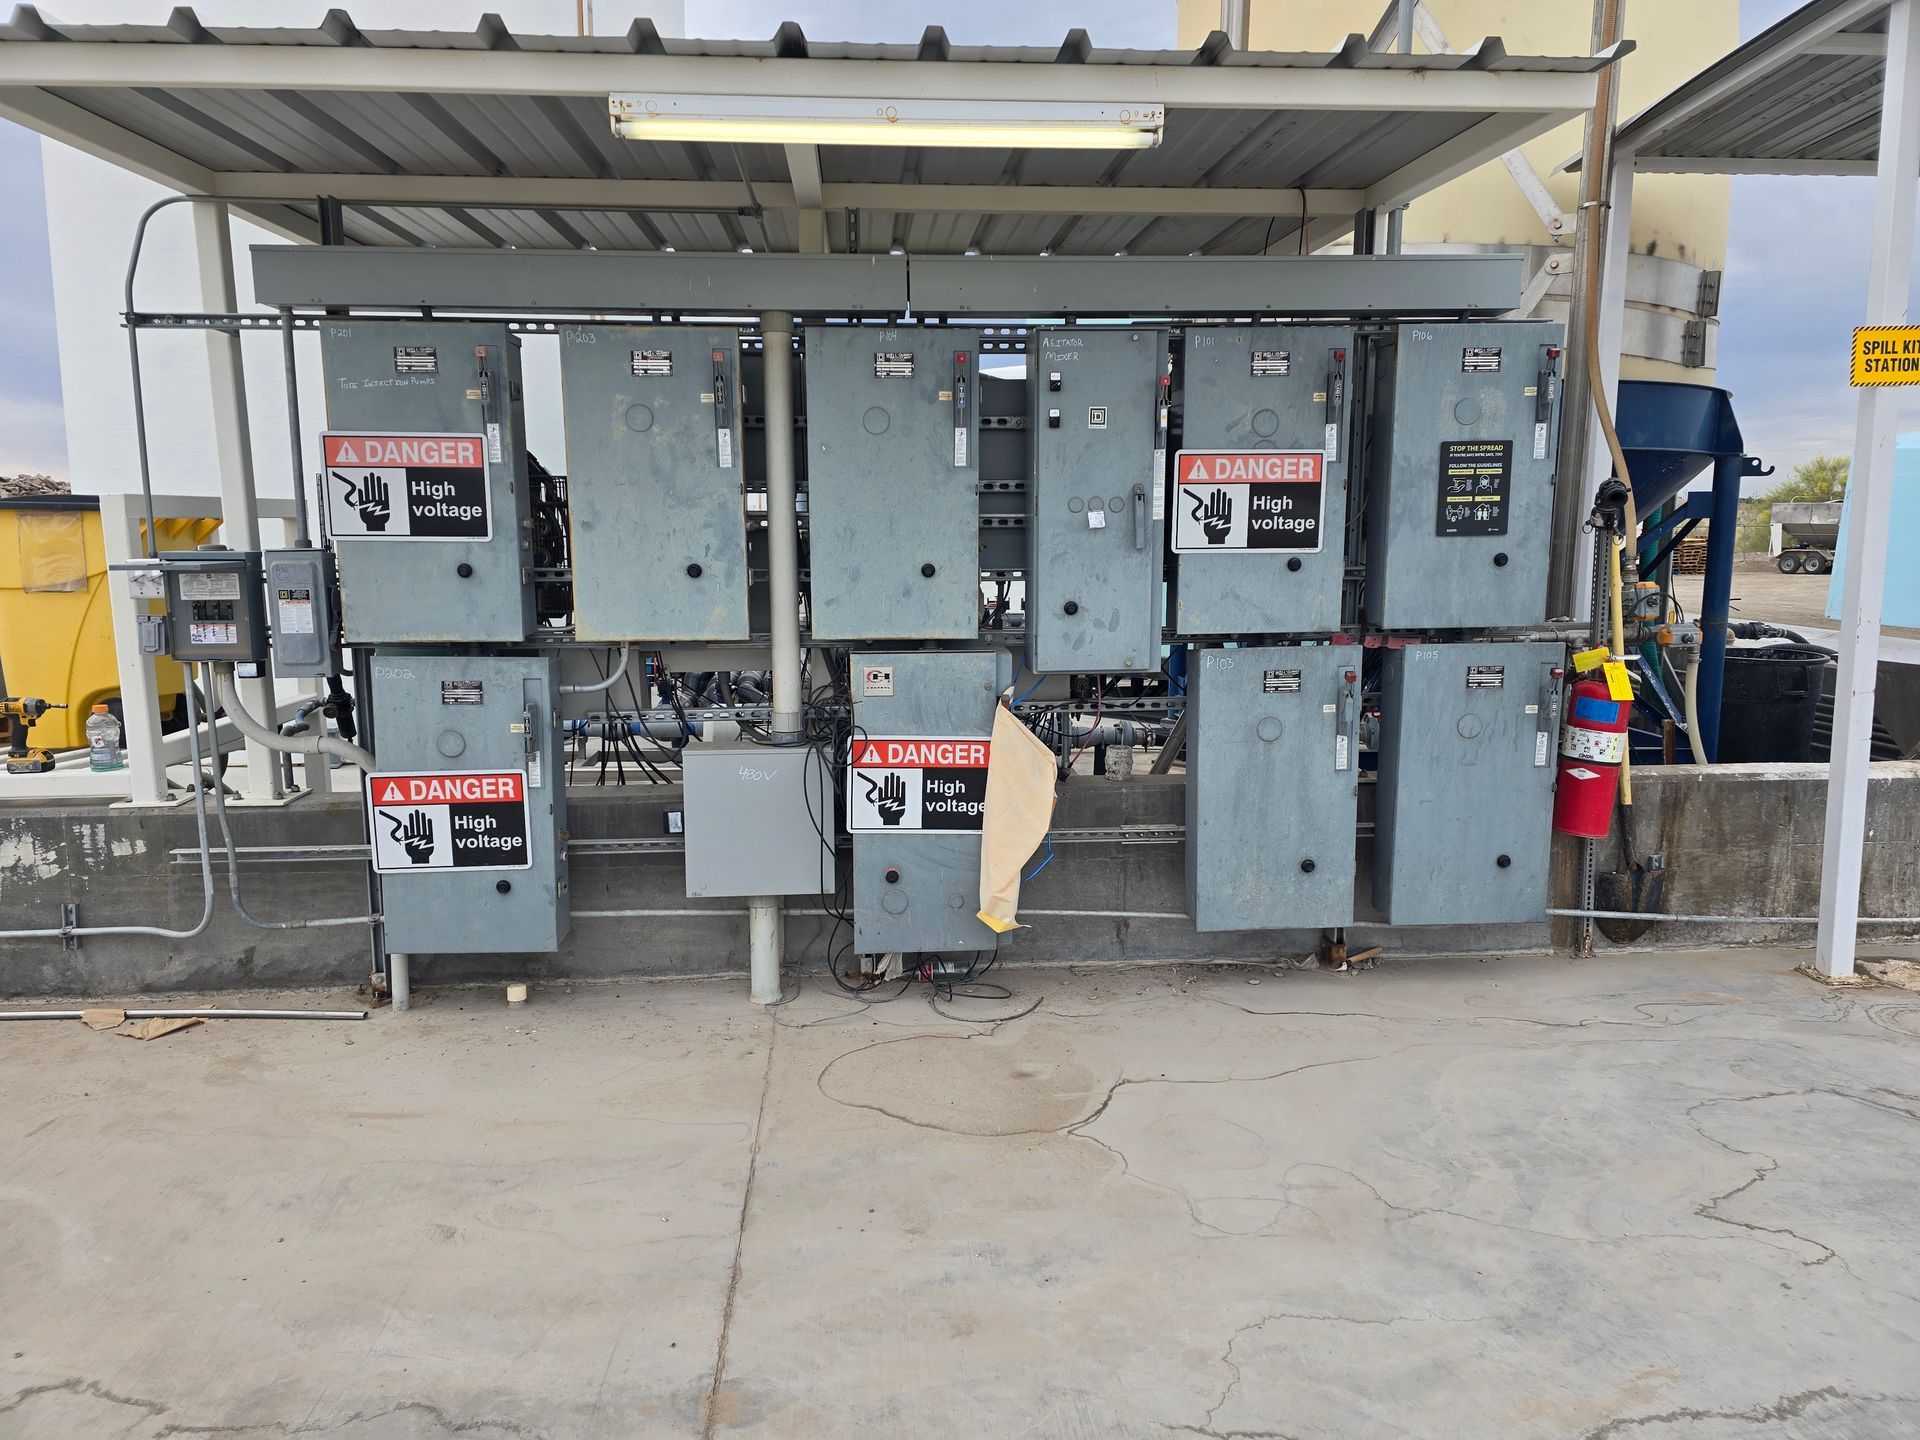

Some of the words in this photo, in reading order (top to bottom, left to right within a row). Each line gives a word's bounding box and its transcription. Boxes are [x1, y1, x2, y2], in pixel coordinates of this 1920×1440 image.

[330, 328, 352, 338] P201
[566, 330, 596, 346] P203
[880, 330, 897, 343] P104
[1042, 337, 1084, 348] AGITATOR
[1195, 335, 1215, 348] P101
[1863, 340, 1898, 355] SPILL
[1045, 351, 1080, 361] MIXER
[1864, 357, 1920, 373] STATION
[365, 440, 475, 465] DANGER
[1215, 458, 1314, 480] DANGER
[411, 480, 456, 500] High
[412, 502, 483, 521] voltage
[1253, 495, 1293, 513] High
[1252, 515, 1316, 533] voltage
[1206, 655, 1235, 670] P103
[1416, 650, 1439, 661] P105
[887, 743, 985, 765] DANGER
[738, 766, 779, 781] 480V
[409, 777, 515, 801] DANGER
[926, 779, 966, 797] High
[925, 798, 986, 815] voltage
[454, 815, 497, 833] High
[455, 835, 523, 851] voltage
